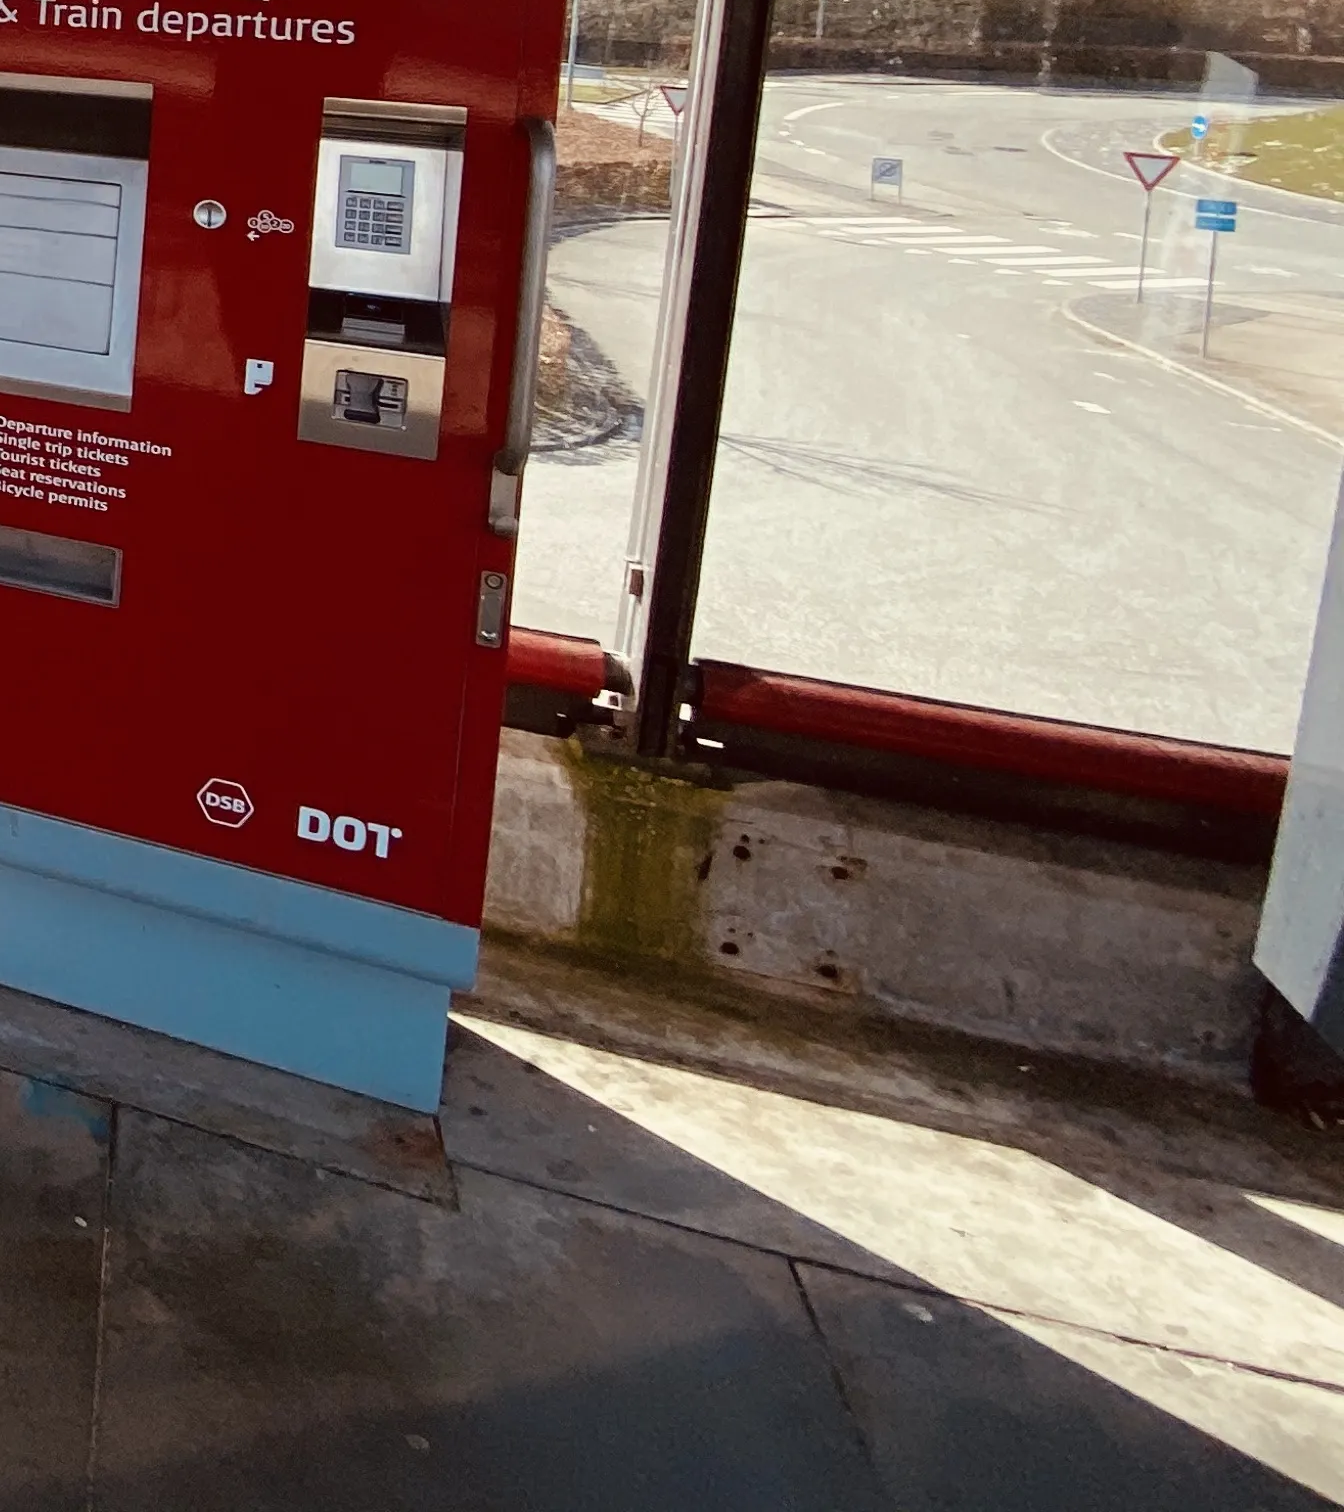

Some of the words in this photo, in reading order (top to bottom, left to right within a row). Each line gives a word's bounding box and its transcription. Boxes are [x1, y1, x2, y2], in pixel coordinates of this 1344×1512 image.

[137, 2, 356, 45] departures
[45, 440, 73, 458] trip
[76, 444, 129, 466] tickets
[77, 428, 172, 457] information
[49, 457, 102, 478] tickets
[29, 471, 127, 499] reservations
[47, 489, 108, 512] permits
[204, 790, 246, 815] DSB
[296, 805, 403, 859] DOT
